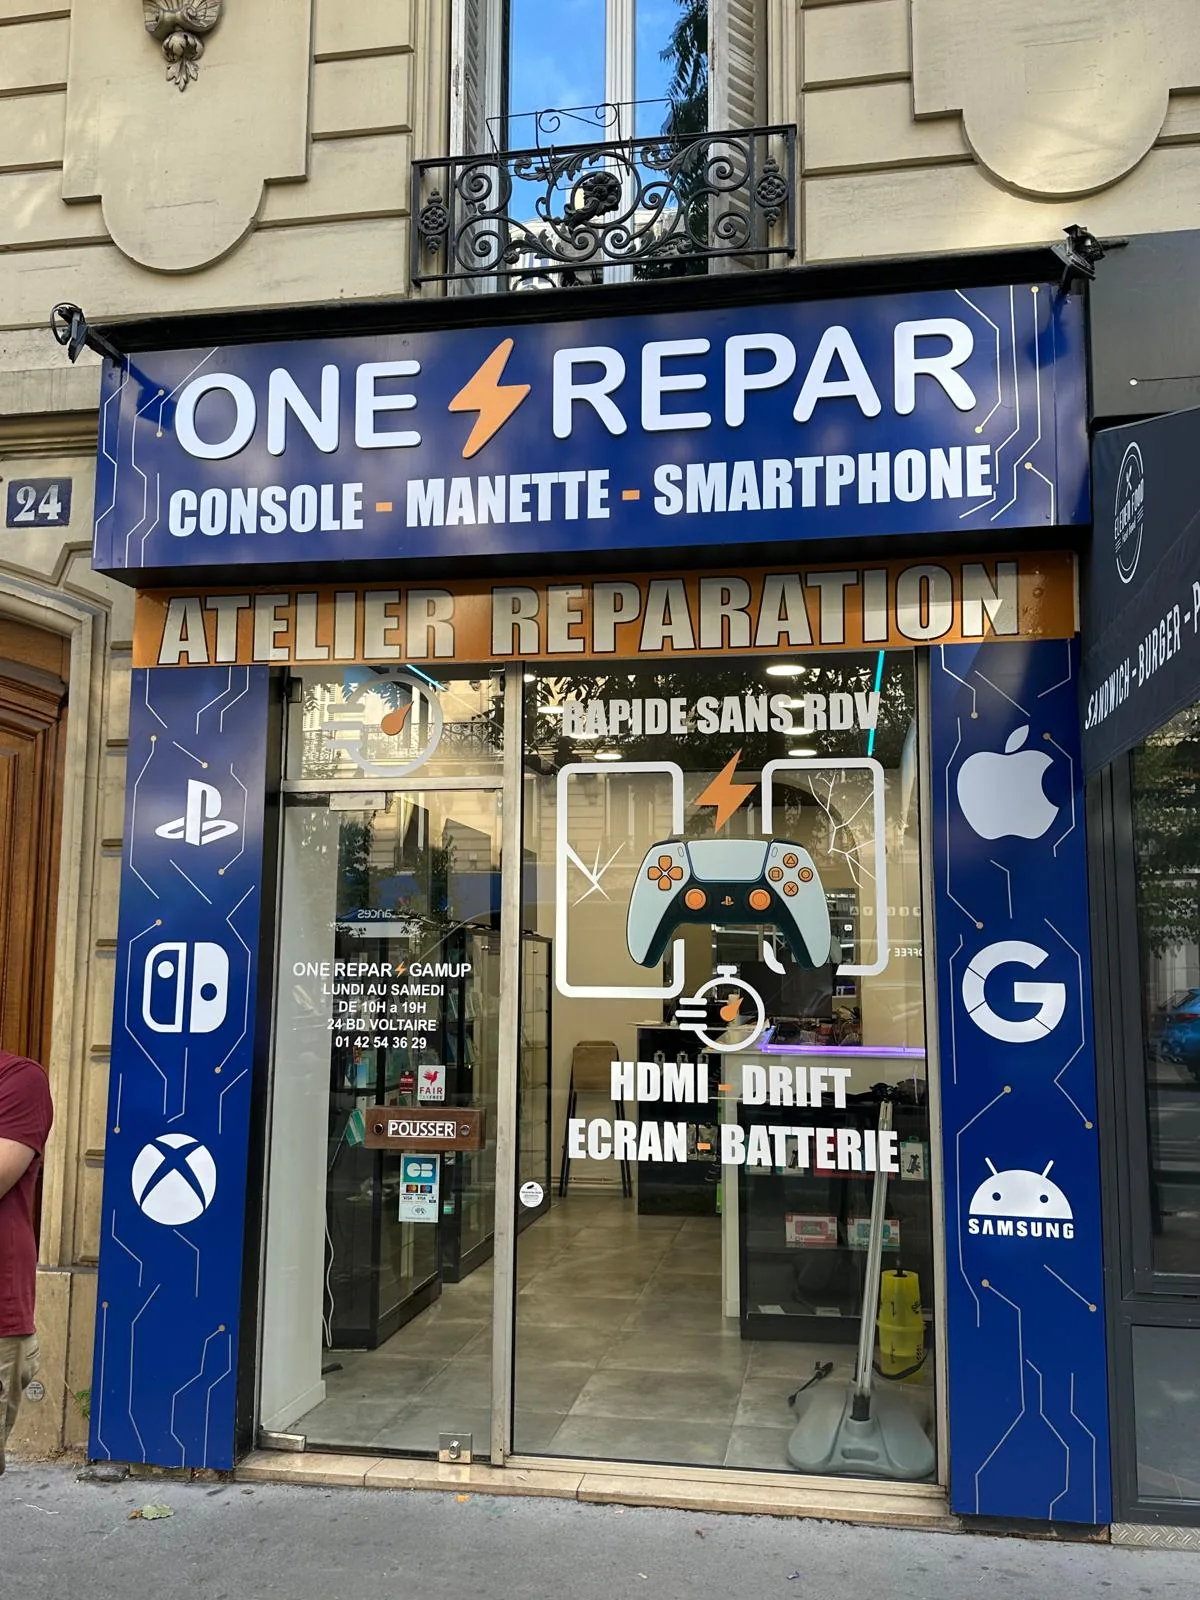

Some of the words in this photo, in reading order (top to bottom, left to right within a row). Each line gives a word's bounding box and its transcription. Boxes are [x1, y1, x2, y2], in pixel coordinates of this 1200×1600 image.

[174, 359, 422, 460] ONE
[552, 317, 978, 439] REPAR
[14, 486, 62, 523] 24
[168, 482, 364, 537] CONSOLE
[406, 468, 611, 528] MANETTE
[653, 444, 992, 516] SMARTPHONE
[158, 588, 456, 667] ATELIER
[490, 560, 1019, 656] REPARATION
[1085, 657, 1130, 730] SANDWICH
[1138, 603, 1181, 688] BURGER
[562, 696, 688, 737] RAPIDE
[697, 695, 795, 735] SANS
[804, 691, 881, 731] RDV
[292, 962, 330, 978] ONE
[335, 962, 392, 978] REPAR
[409, 962, 472, 978] GAMUP
[323, 984, 364, 995] LUNDI
[367, 984, 387, 996] AU
[390, 984, 444, 997] SAMEDI
[338, 1001, 357, 1013] DE
[362, 1001, 386, 1013] 10H
[401, 1002, 426, 1014] 19H
[327, 1019, 344, 1030] 24
[346, 1019, 366, 1030] BD
[369, 1019, 437, 1032] VOLTAIRE
[335, 1036, 350, 1047] 01
[354, 1036, 370, 1048] 42
[373, 1037, 389, 1048] 54
[392, 1037, 408, 1049] 36
[411, 1037, 427, 1049] 29
[419, 1086, 443, 1095] FAIR
[610, 1061, 709, 1104] HDMI
[741, 1064, 852, 1109] DRIFT
[389, 1122, 454, 1136] POUSSER
[568, 1118, 688, 1163] ECRAN
[720, 1123, 900, 1173] BATTERIE
[967, 1217, 1074, 1239] SAMSUNG
